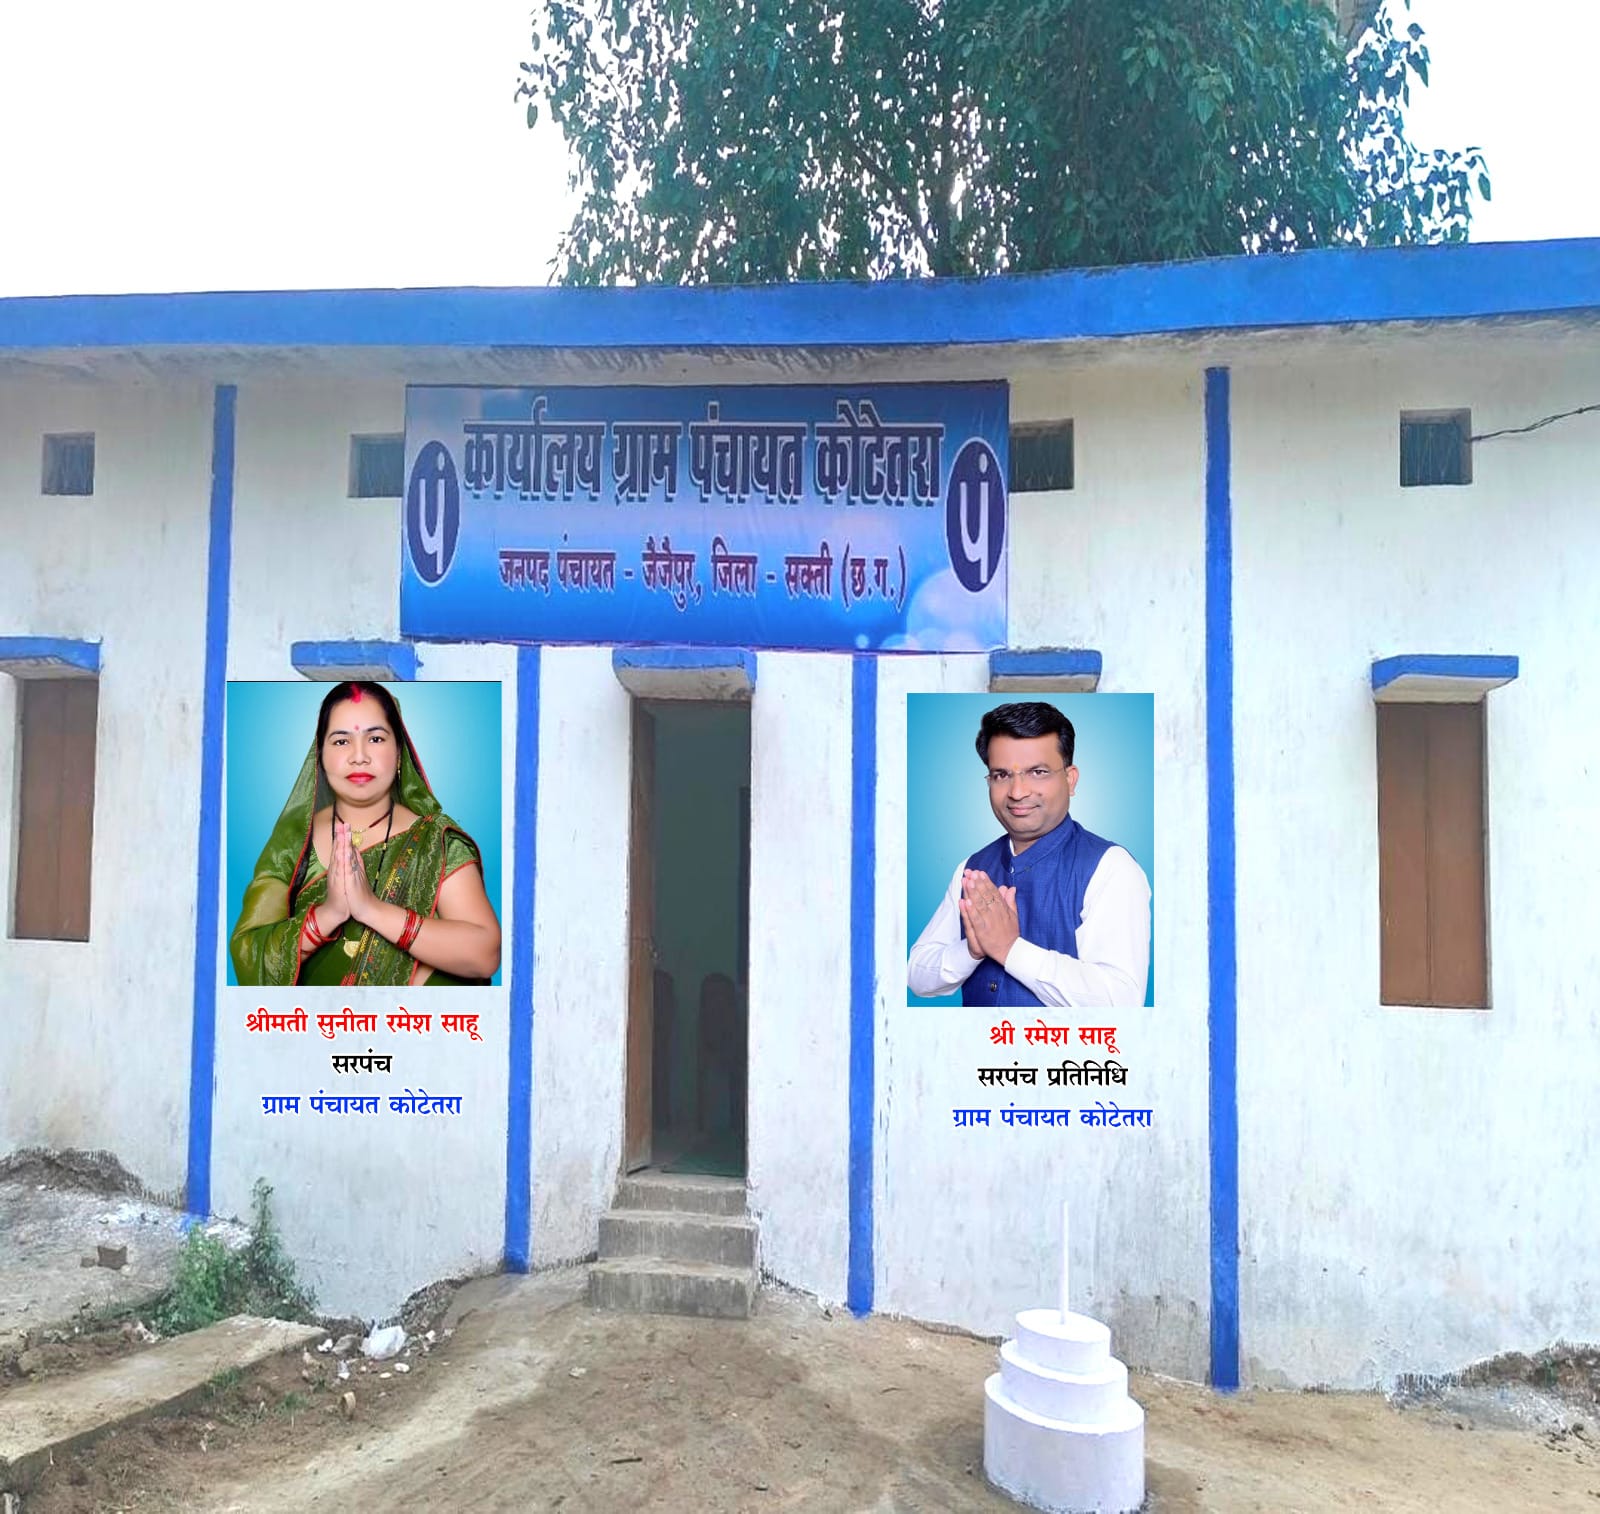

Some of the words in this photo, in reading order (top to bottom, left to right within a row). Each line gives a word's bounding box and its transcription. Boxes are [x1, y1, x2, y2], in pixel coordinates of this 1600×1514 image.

[463, 395, 606, 498] कार्यालय
[612, 421, 682, 501] ग्राम
[689, 401, 807, 500] पंचायत
[815, 400, 944, 503] कोटेतरा
[499, 549, 551, 597] जनपद
[557, 533, 616, 592] पंचायत
[711, 535, 758, 598] जिला
[784, 541, 833, 600] सक्ती
